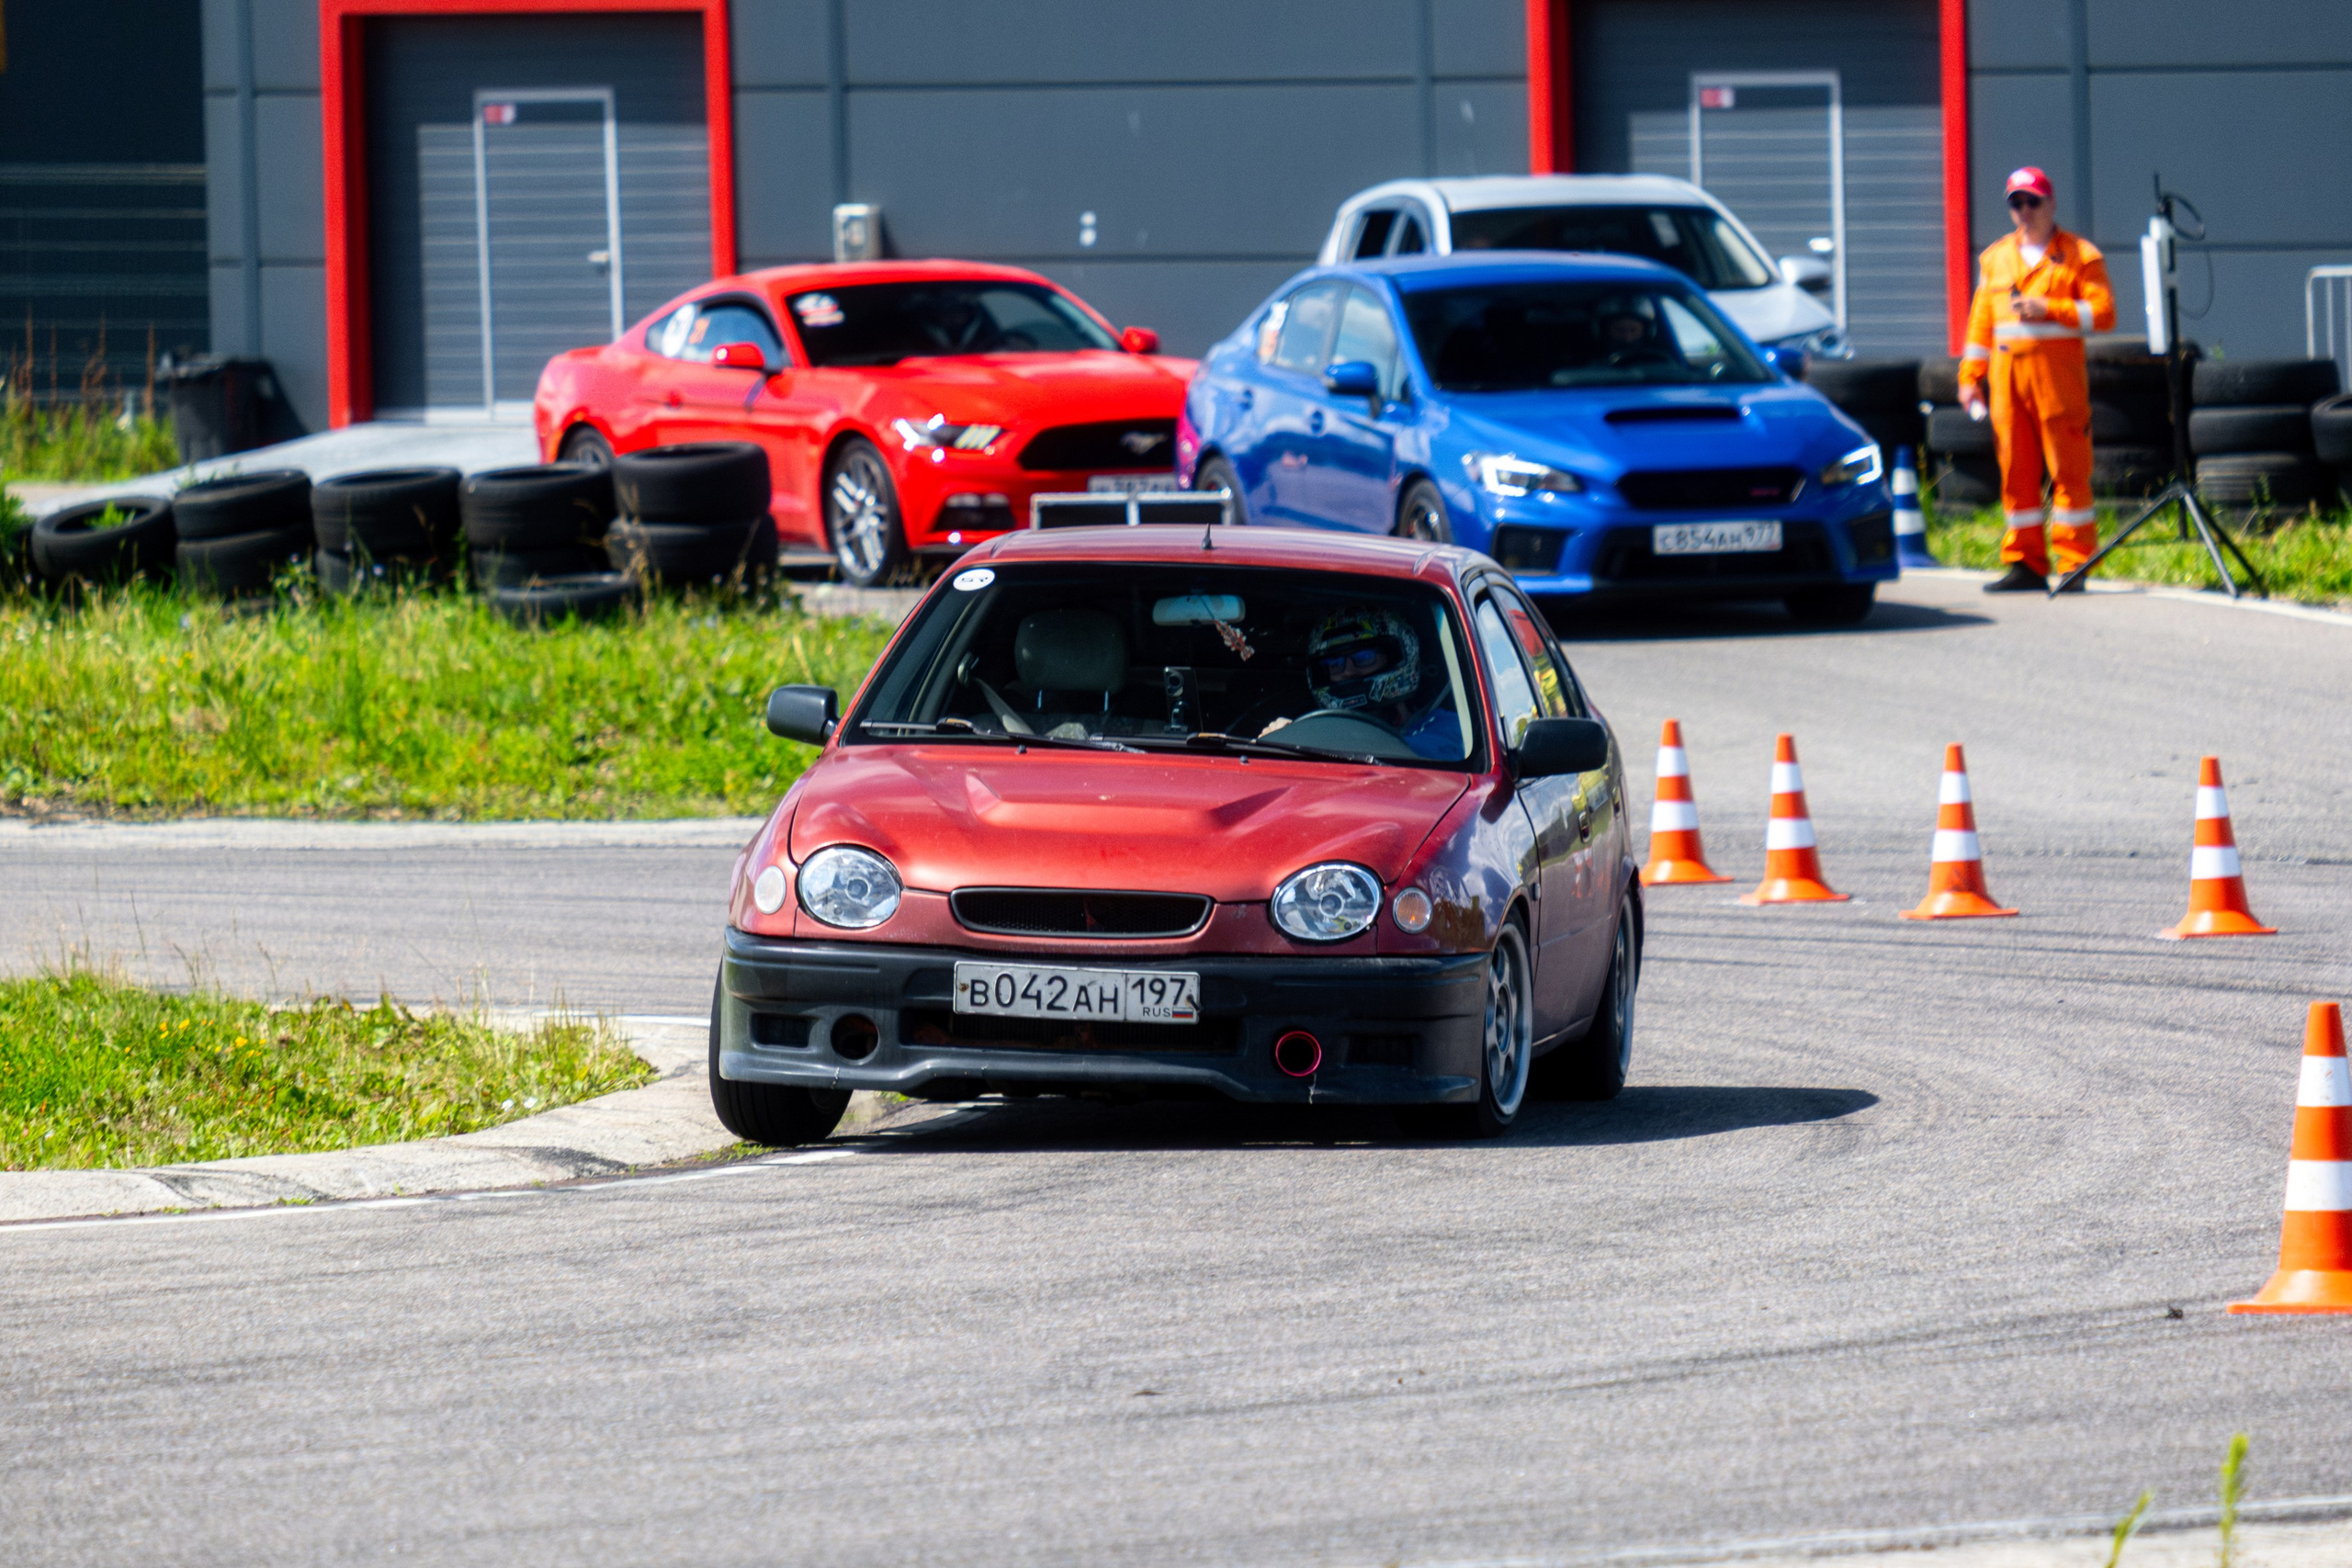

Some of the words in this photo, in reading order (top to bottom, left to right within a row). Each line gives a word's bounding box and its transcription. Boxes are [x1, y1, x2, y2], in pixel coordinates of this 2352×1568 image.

[969, 970, 1119, 1014] В042АН
[1131, 976, 1187, 1007] 197
[1142, 1007, 1171, 1018] RUS
